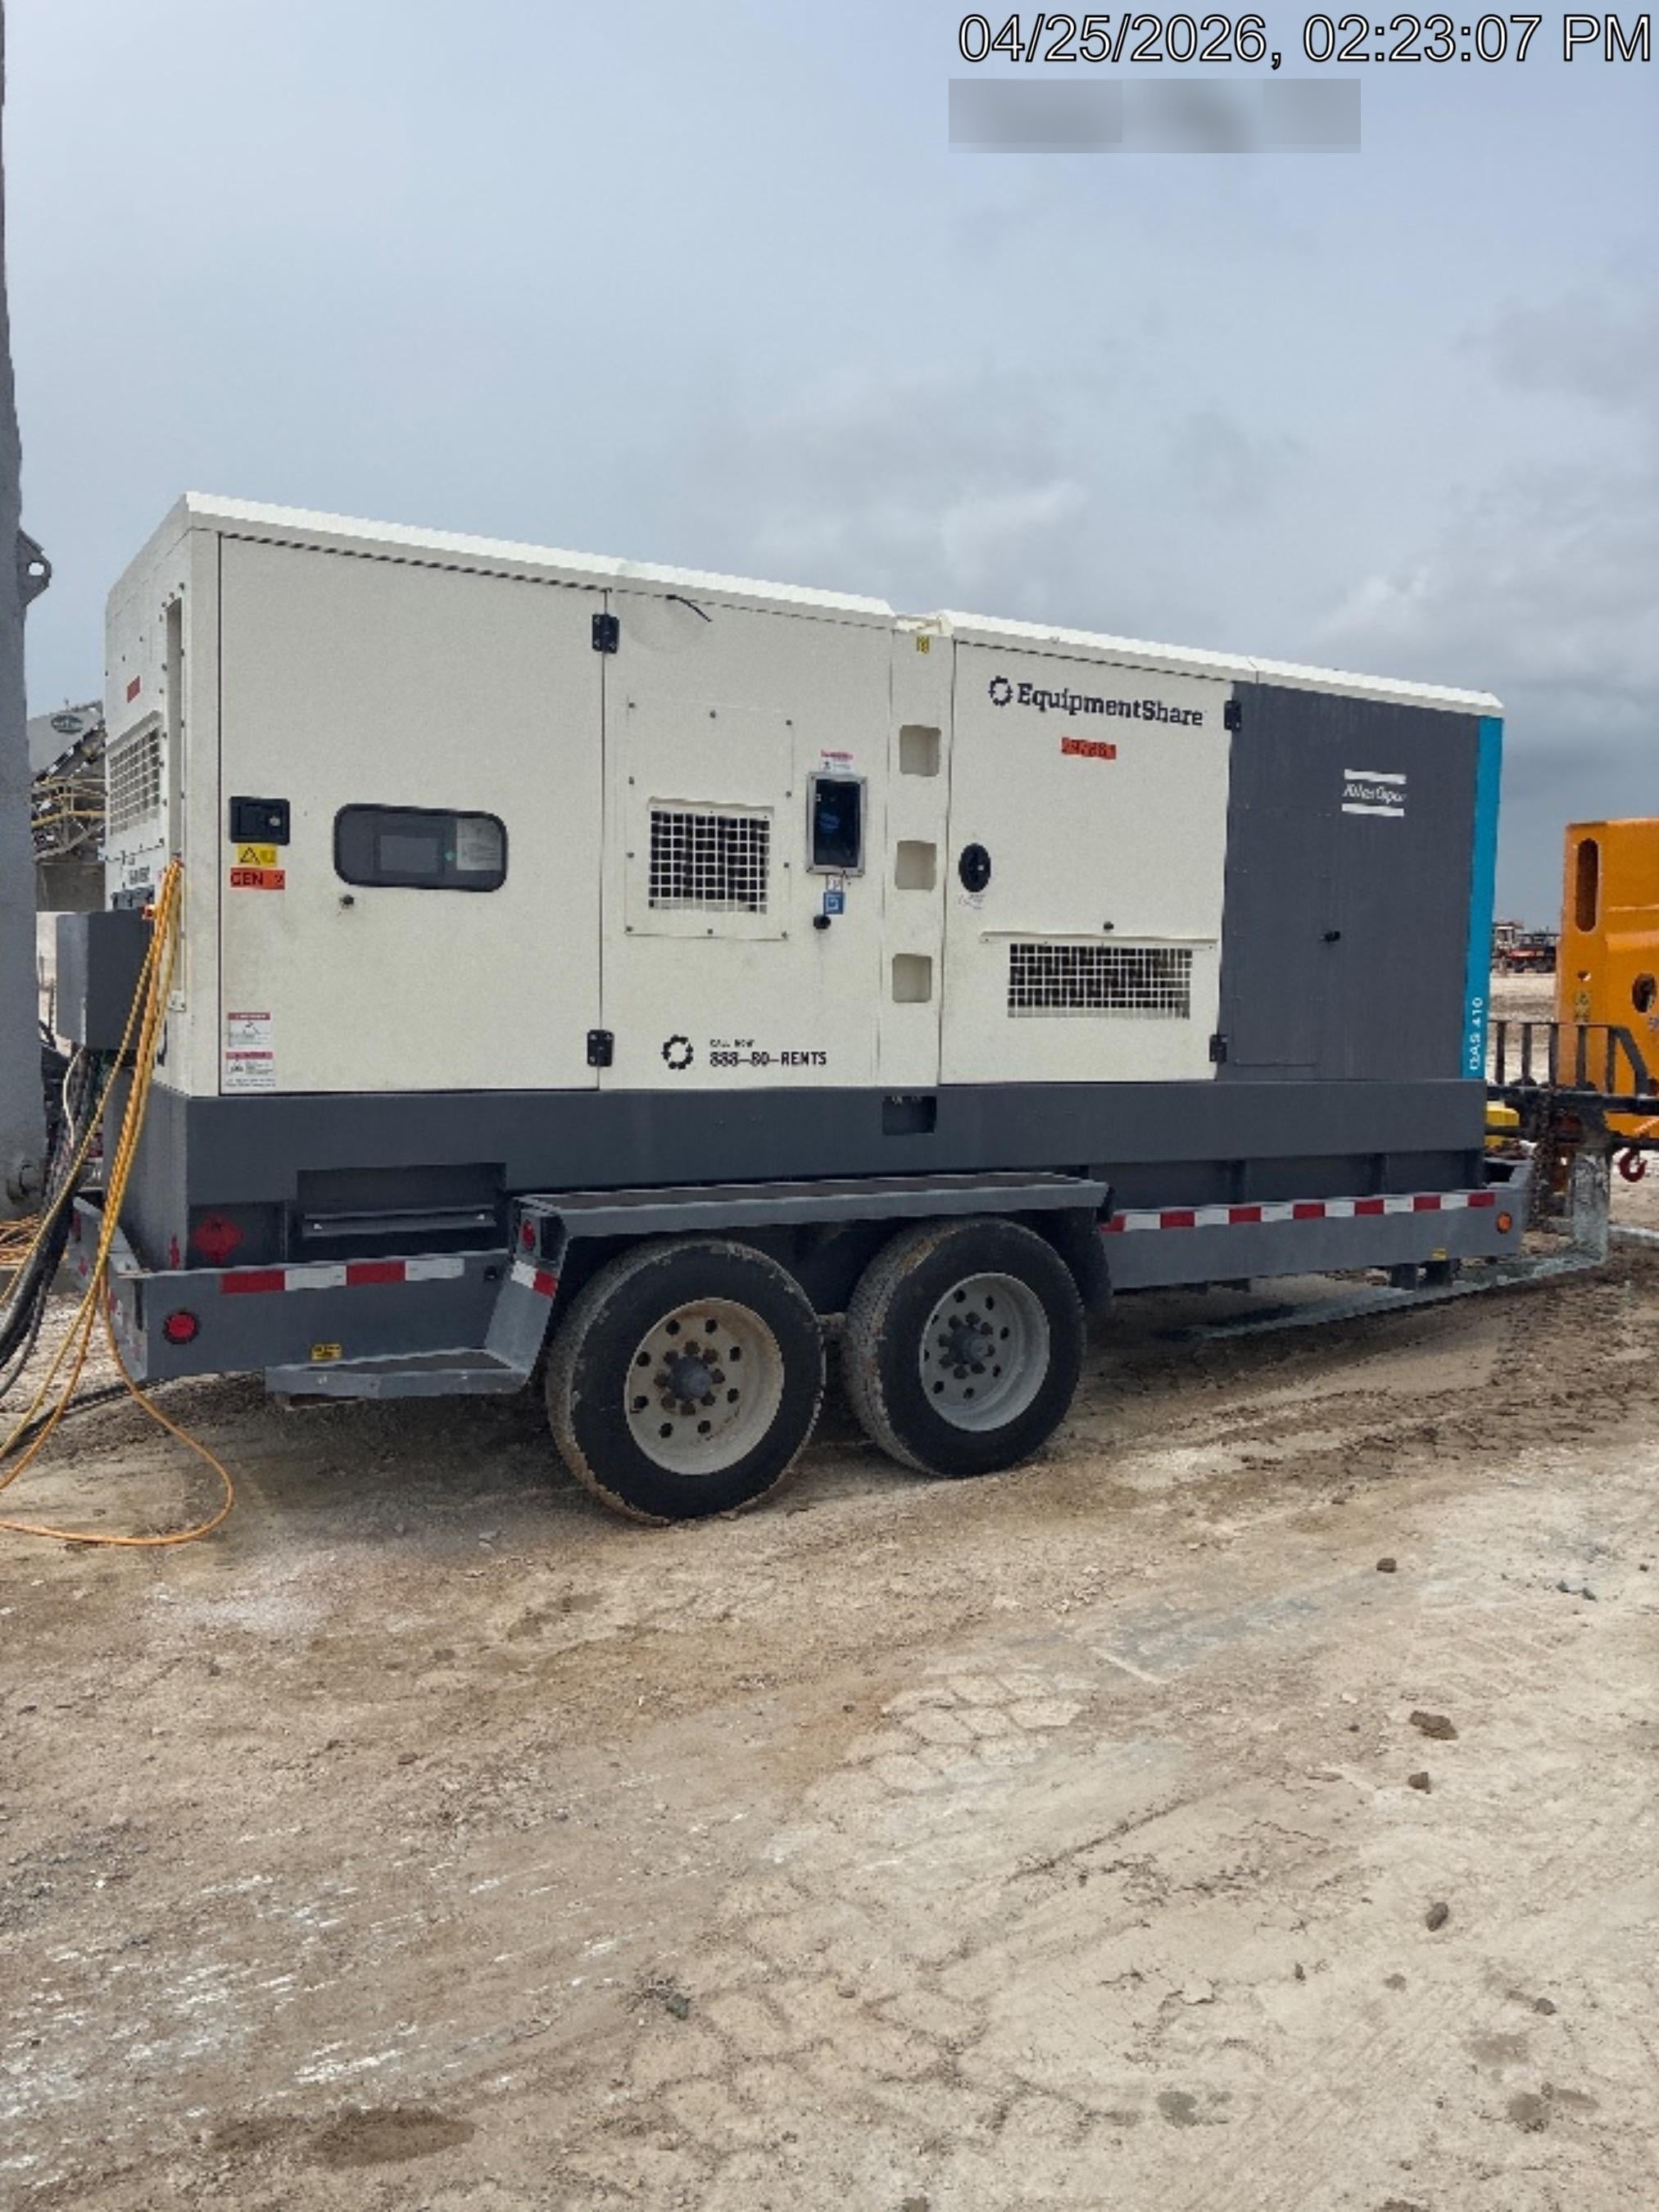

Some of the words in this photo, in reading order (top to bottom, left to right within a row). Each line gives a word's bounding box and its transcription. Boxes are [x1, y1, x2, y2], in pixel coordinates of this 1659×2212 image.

[1017, 682, 1203, 726] EquipmentShare
[1471, 997, 1483, 1027] 410
[709, 1051, 827, 1067] 888-80-RENTS
